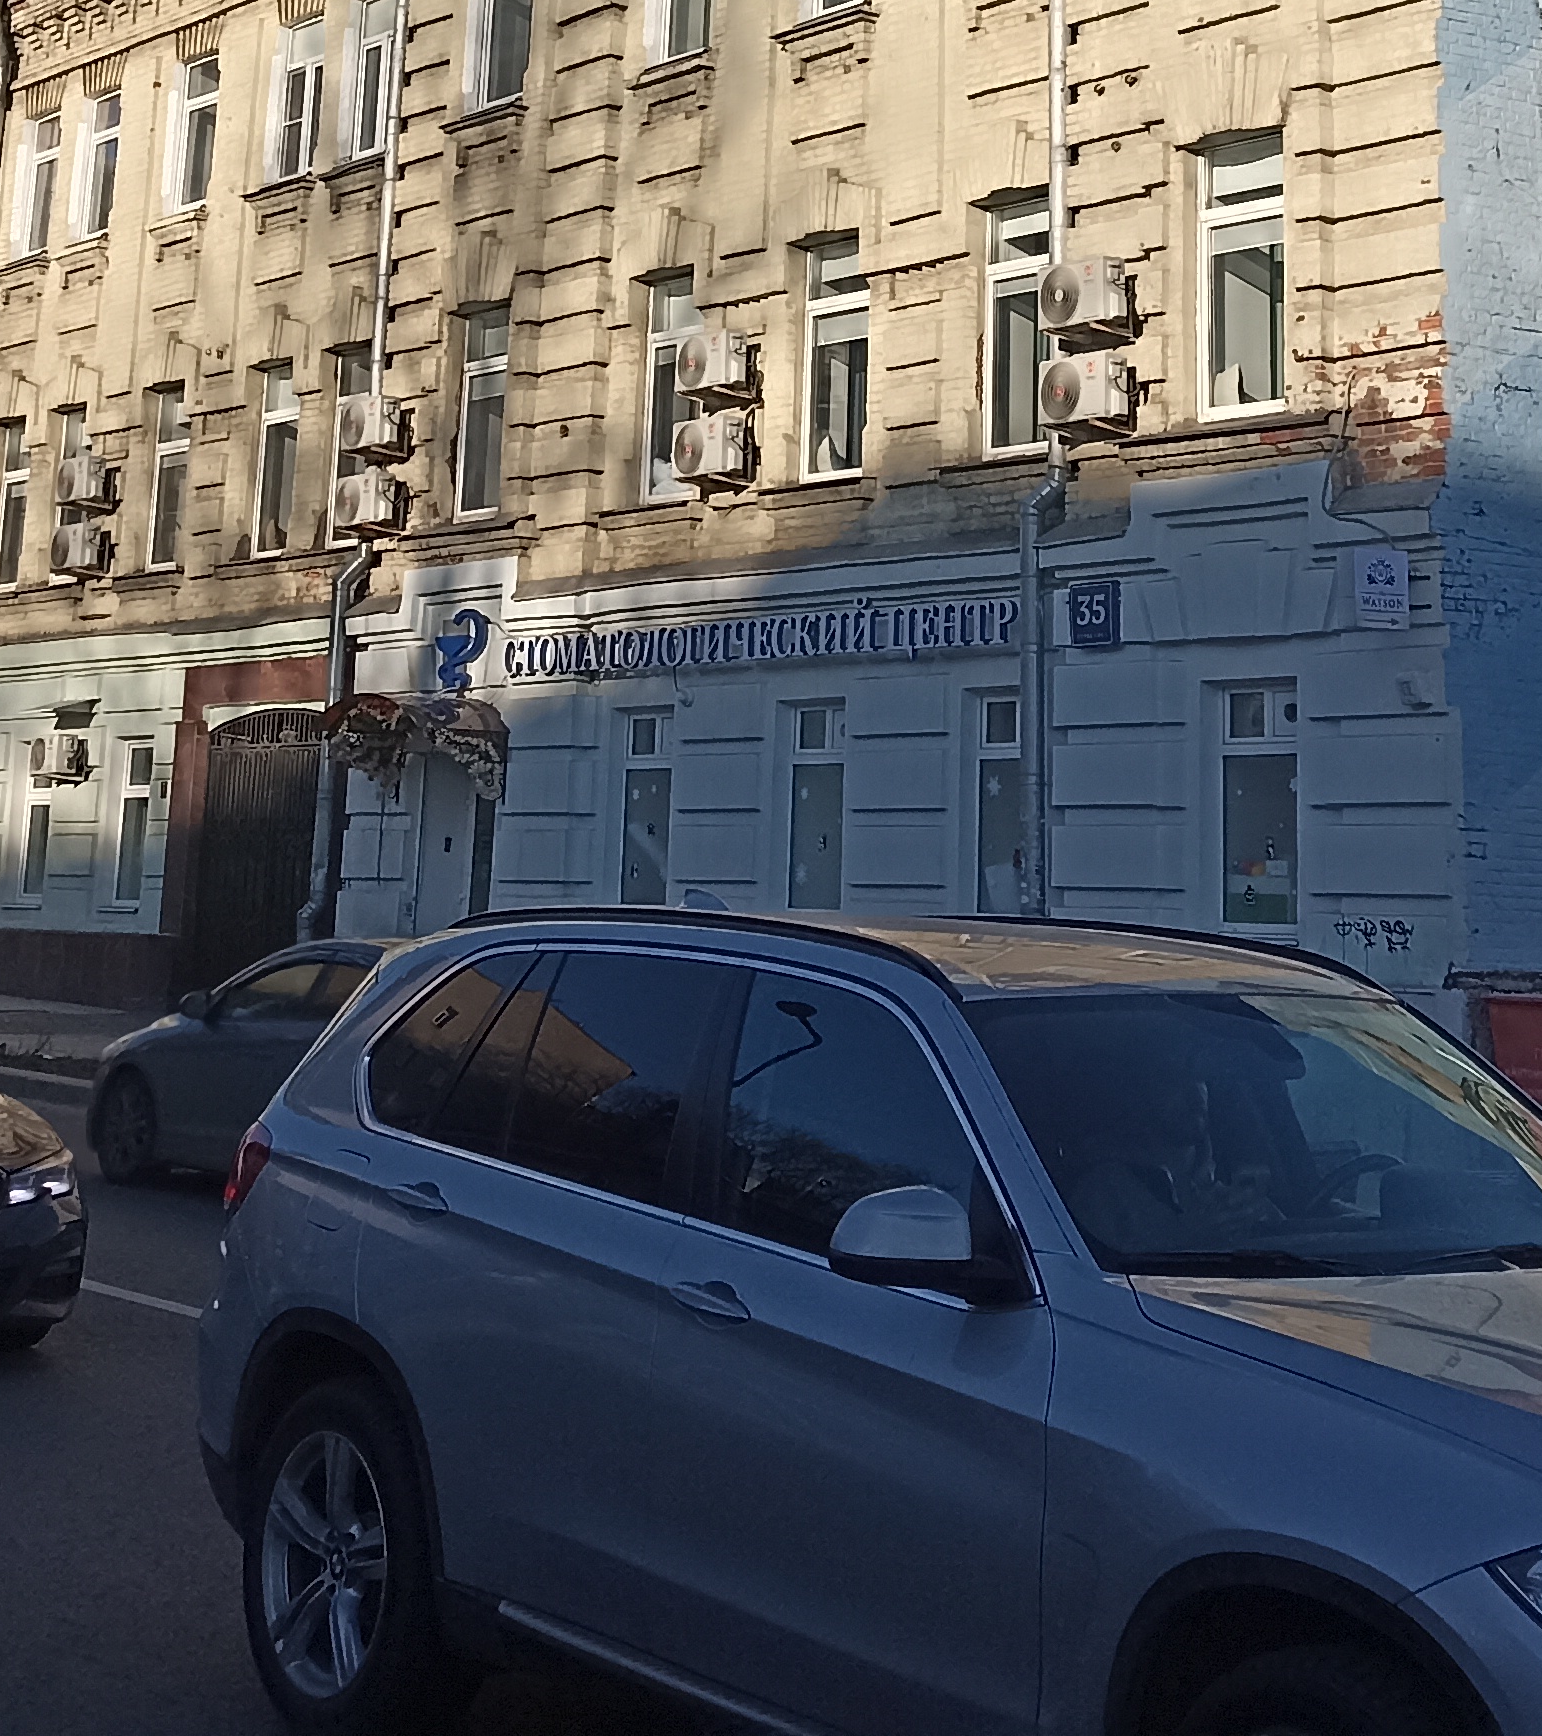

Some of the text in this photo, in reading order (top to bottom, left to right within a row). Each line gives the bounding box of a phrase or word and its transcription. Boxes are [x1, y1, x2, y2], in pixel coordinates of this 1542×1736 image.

[1076, 593, 1106, 626] 35
[1361, 595, 1405, 610] WATSON
[504, 597, 1019, 678] СТОМАТОЛОГИЧЕСКИЙ ЦЕНТР
